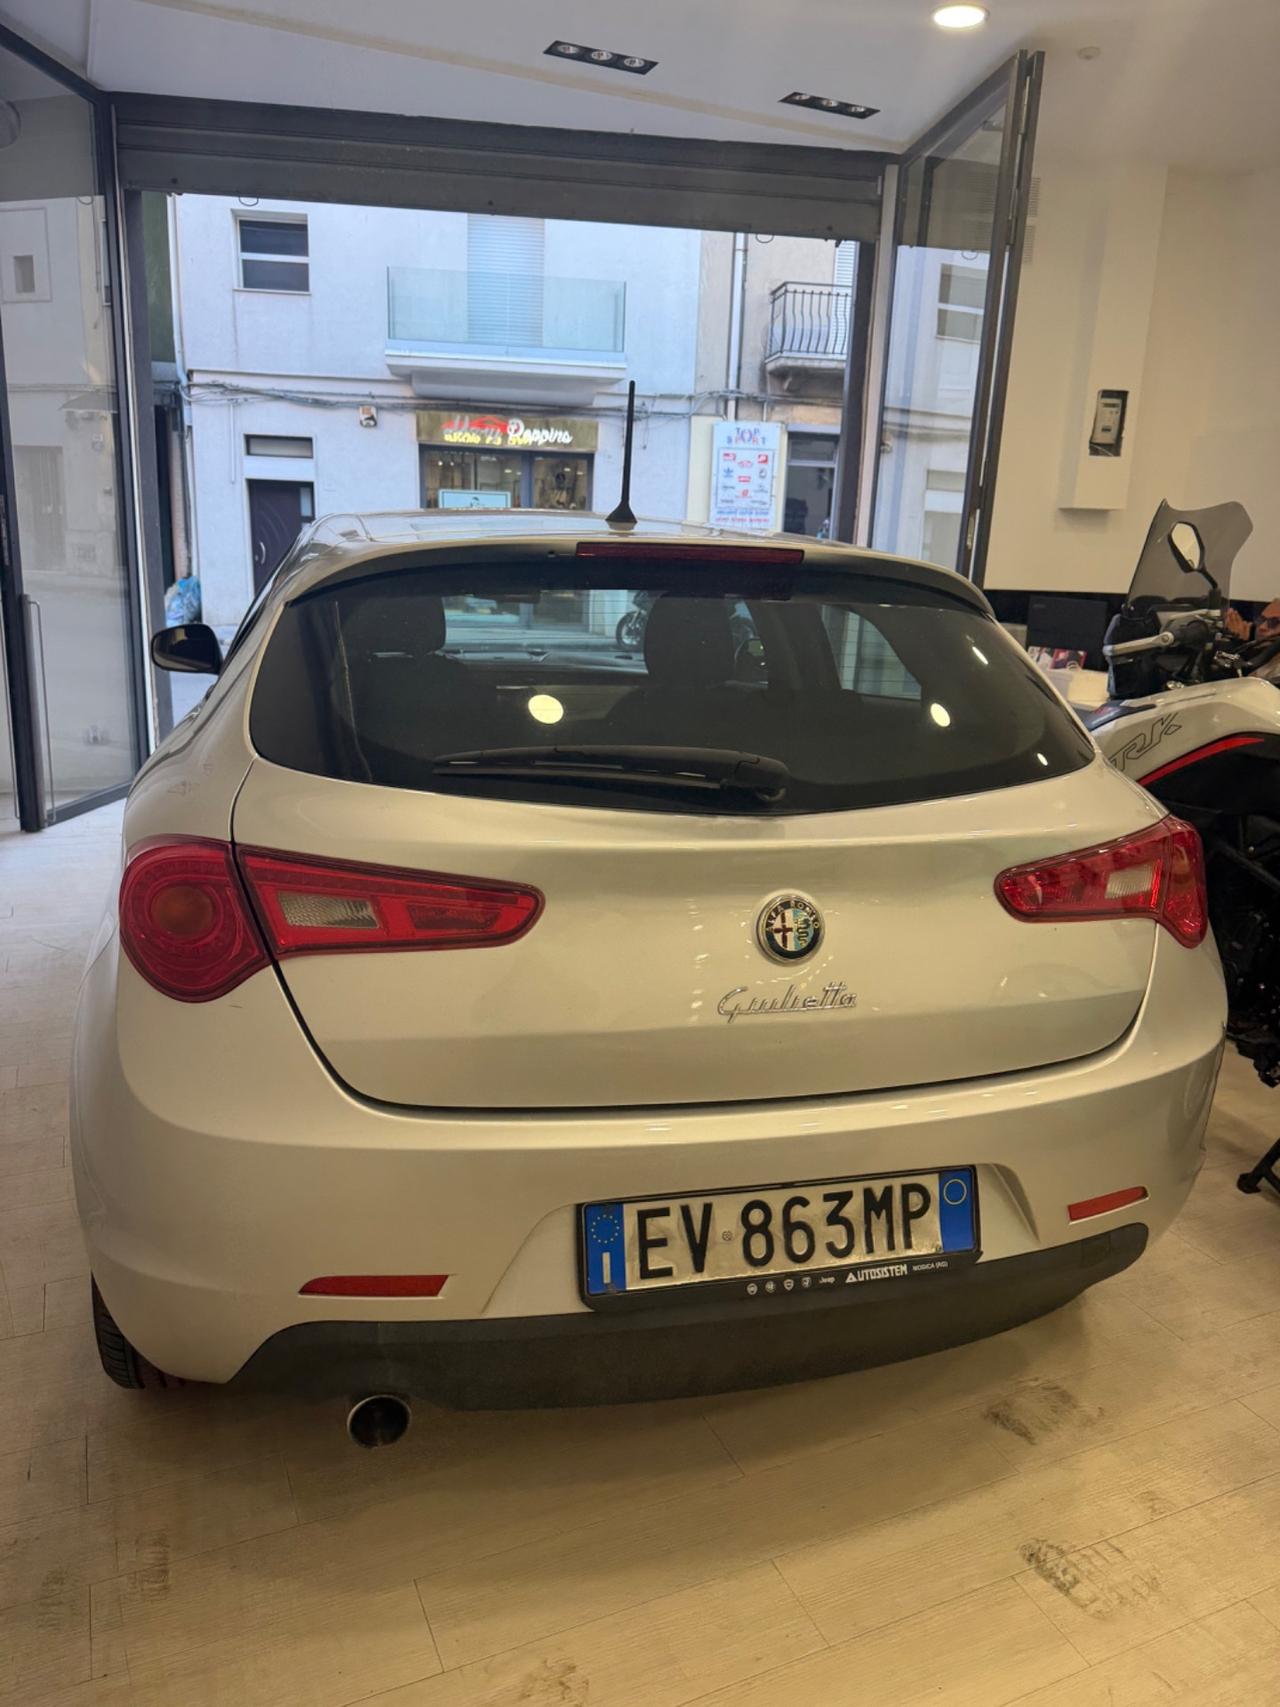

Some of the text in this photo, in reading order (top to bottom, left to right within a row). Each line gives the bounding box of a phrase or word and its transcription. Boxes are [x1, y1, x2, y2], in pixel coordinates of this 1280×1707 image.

[507, 418, 573, 445] Poppins
[717, 981, 857, 1024] Giulietta
[637, 1202, 713, 1280] EV
